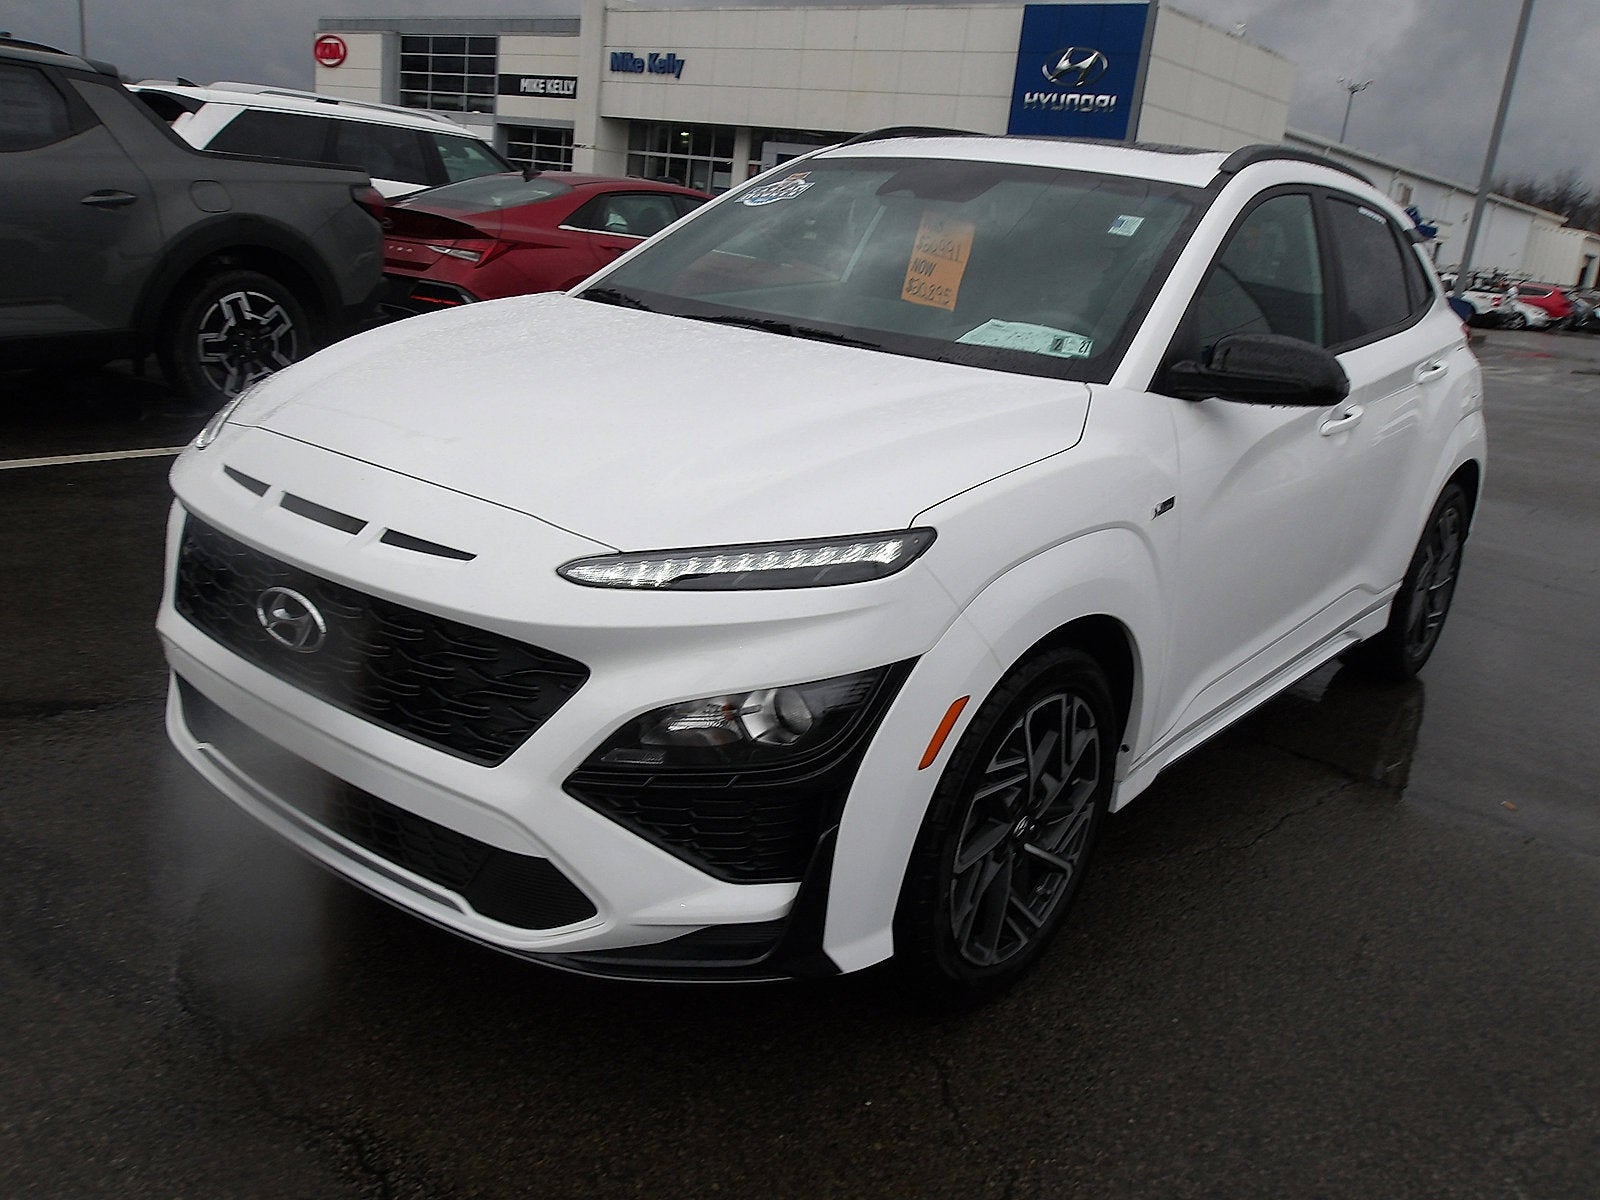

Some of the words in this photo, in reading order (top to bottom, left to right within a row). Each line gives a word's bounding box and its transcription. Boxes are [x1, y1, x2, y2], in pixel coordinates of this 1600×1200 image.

[610, 52, 645, 74] Mike
[648, 52, 685, 80] Kelly
[520, 78, 545, 93] MIKE
[546, 79, 576, 95] KELLY
[1023, 91, 1118, 113] HYUNDAI
[911, 257, 937, 277] NOW
